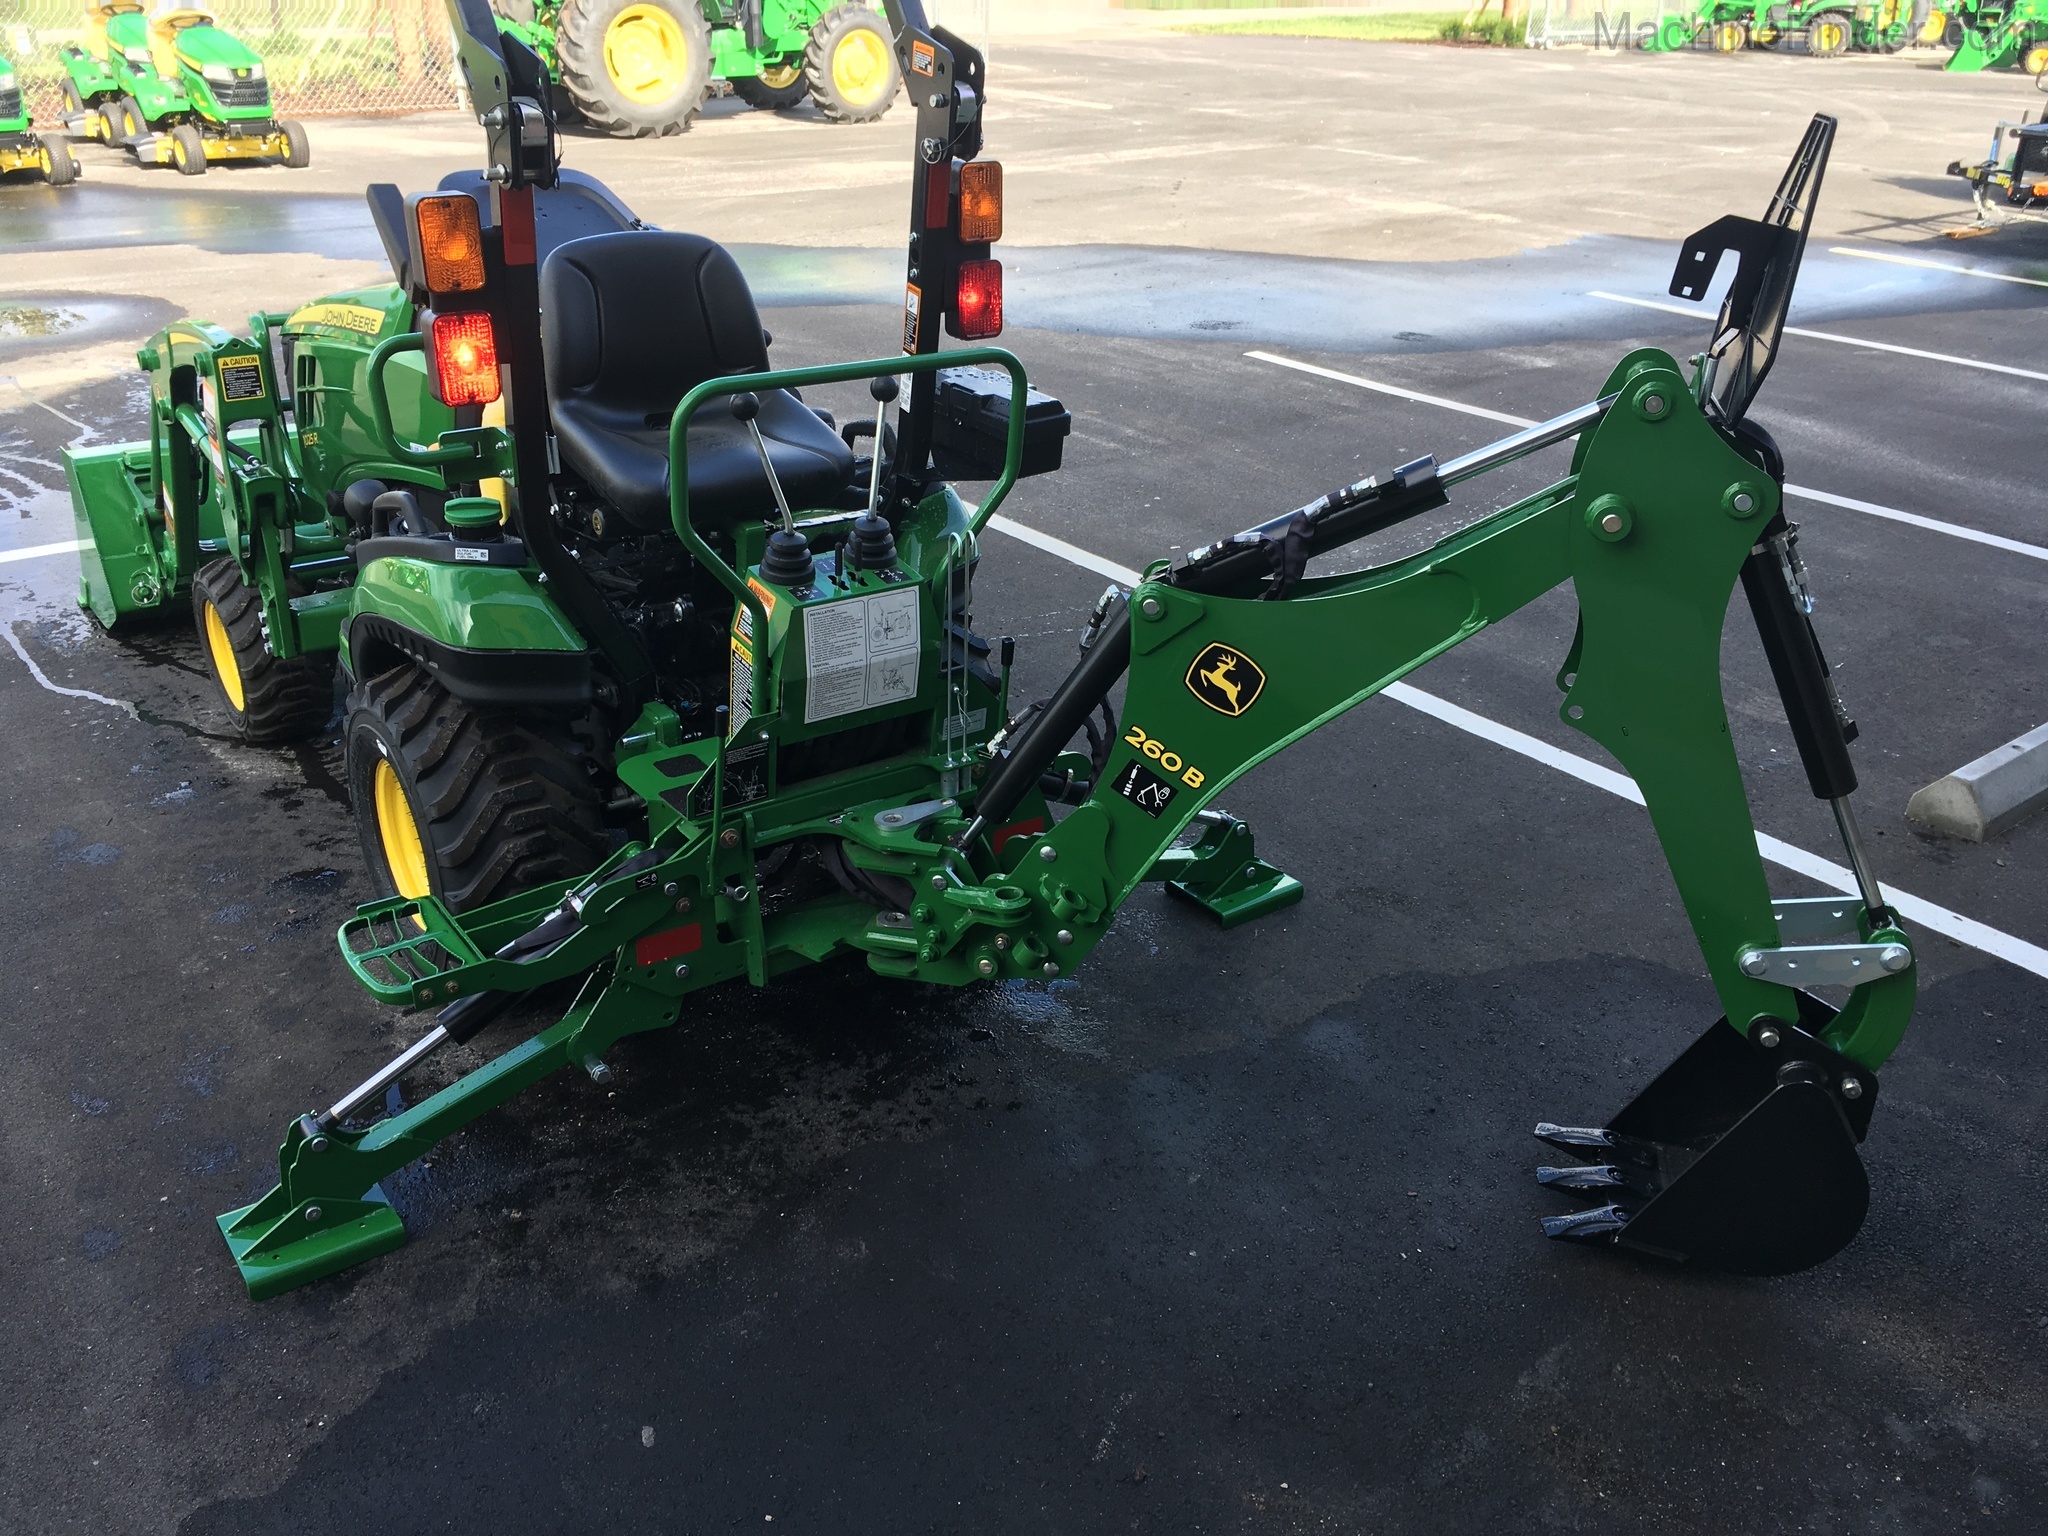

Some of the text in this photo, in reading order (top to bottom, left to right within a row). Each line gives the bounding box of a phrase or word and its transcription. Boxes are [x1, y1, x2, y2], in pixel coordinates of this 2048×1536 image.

[320, 307, 378, 332] JOHN DEERE
[229, 356, 258, 366] CAUTION
[809, 609, 835, 617] INSTALLATION
[1123, 725, 1205, 789] 260 B
